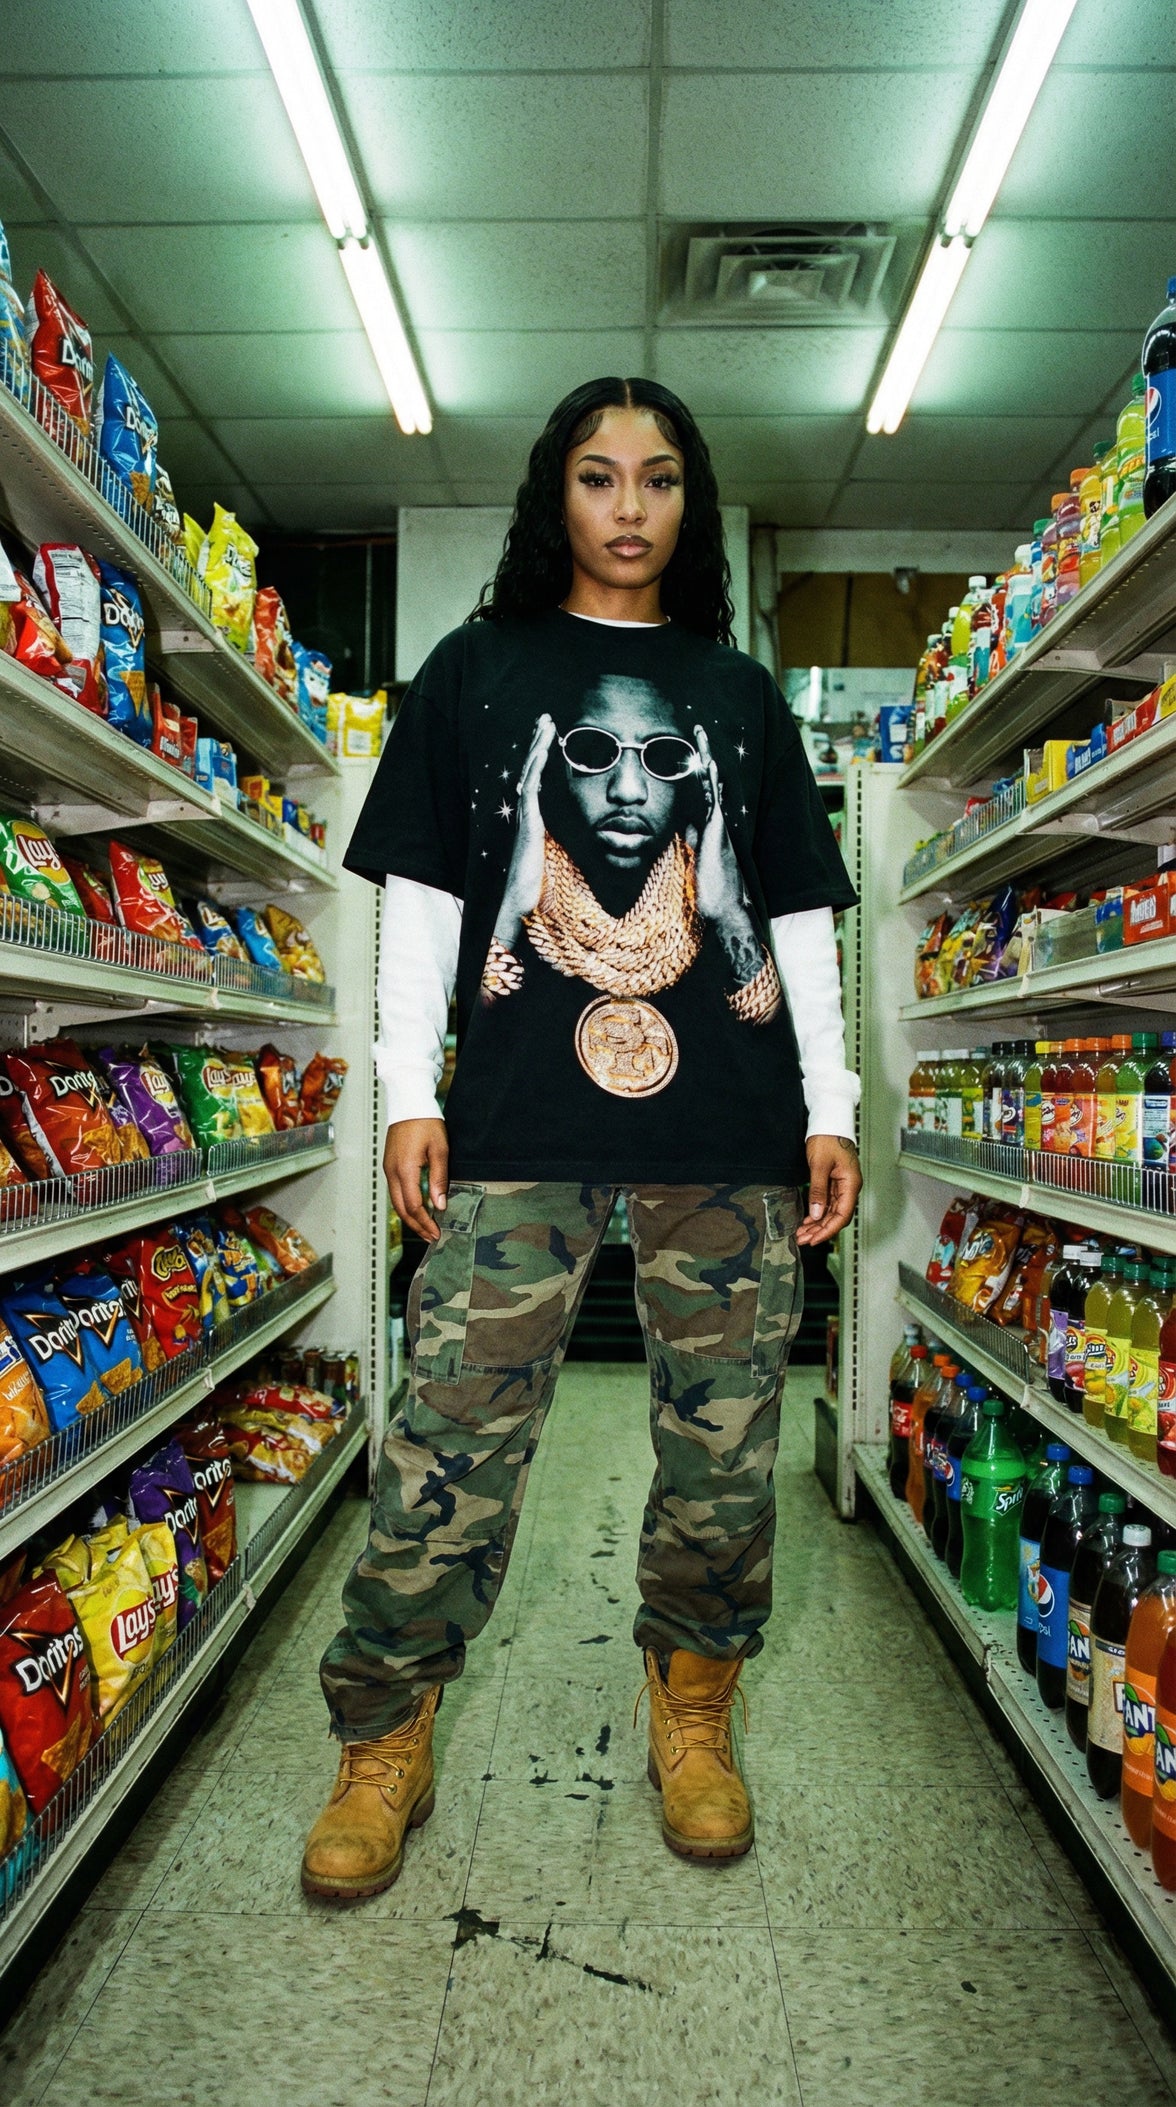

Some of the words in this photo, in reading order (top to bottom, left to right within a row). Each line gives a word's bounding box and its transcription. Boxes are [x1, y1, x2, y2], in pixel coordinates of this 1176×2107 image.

[29, 1318, 79, 1361] Dorit
[117, 1596, 156, 1653] Lay's
[15, 1625, 84, 1692] Doritos
[1124, 1699, 1156, 1733] ANT
